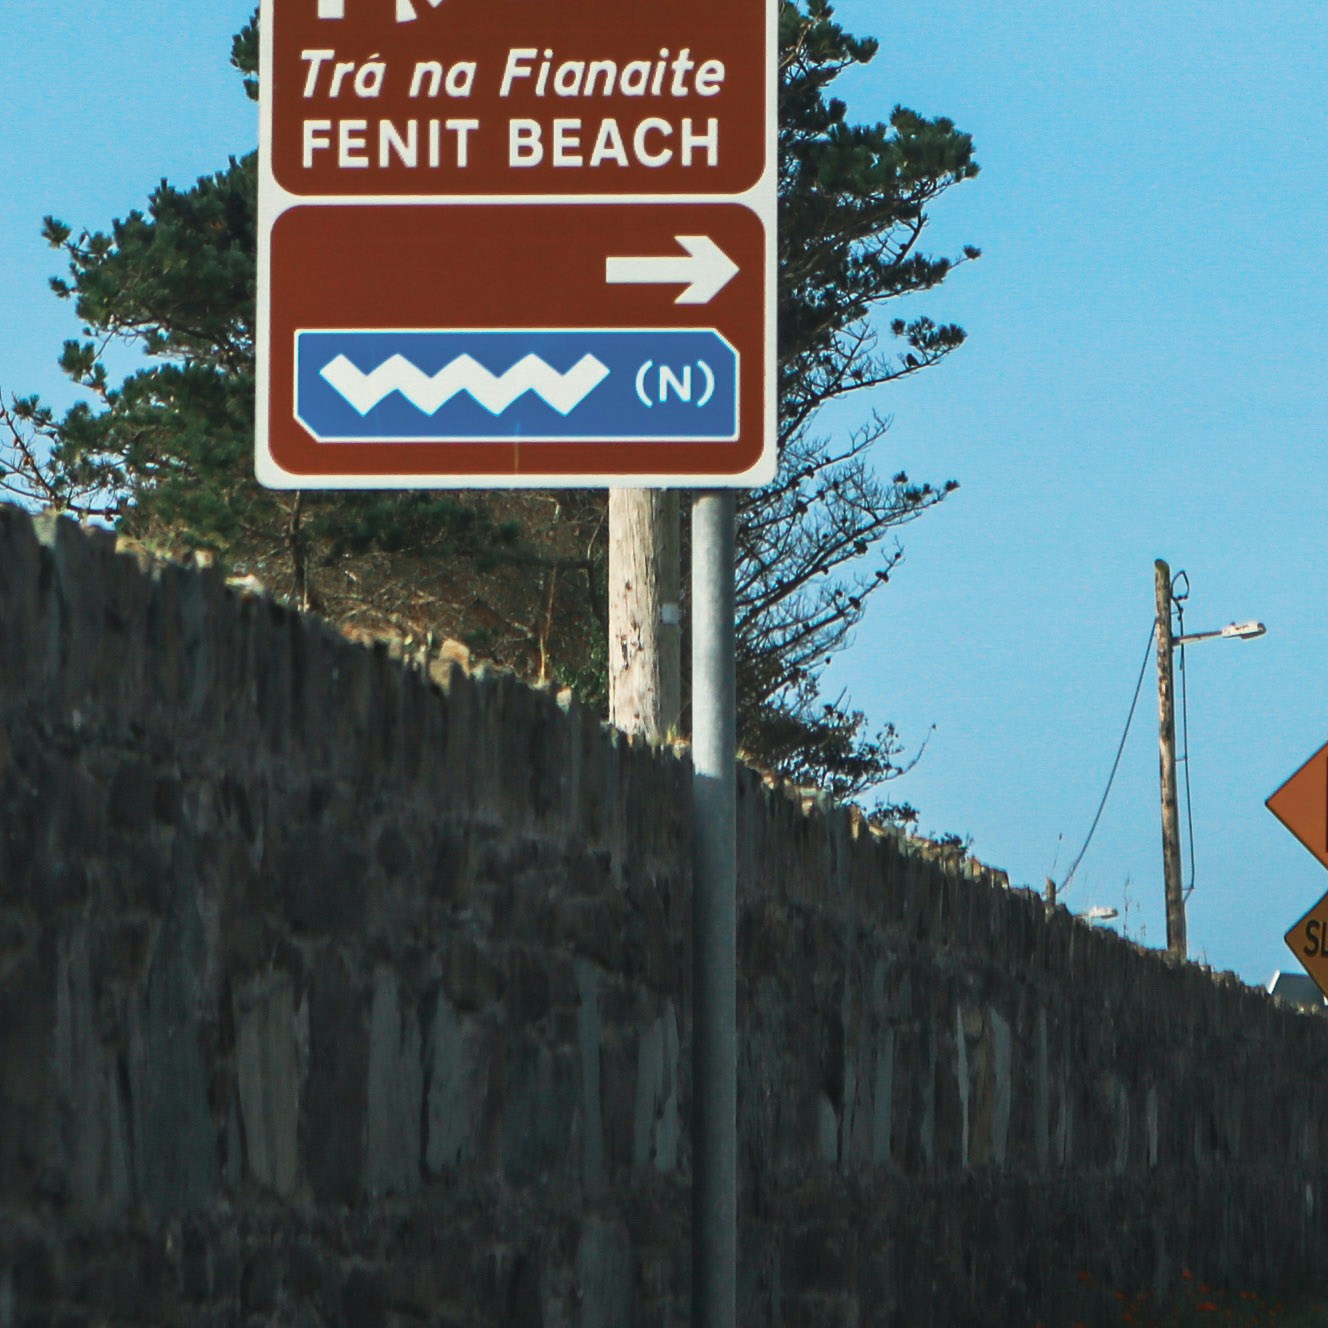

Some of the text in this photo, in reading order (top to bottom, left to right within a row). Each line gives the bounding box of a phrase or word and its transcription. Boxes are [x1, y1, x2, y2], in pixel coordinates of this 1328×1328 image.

[300, 48, 725, 97] Trá na Fianaite
[302, 117, 718, 168] FENIT BEACH
[635, 359, 715, 408] (N)
